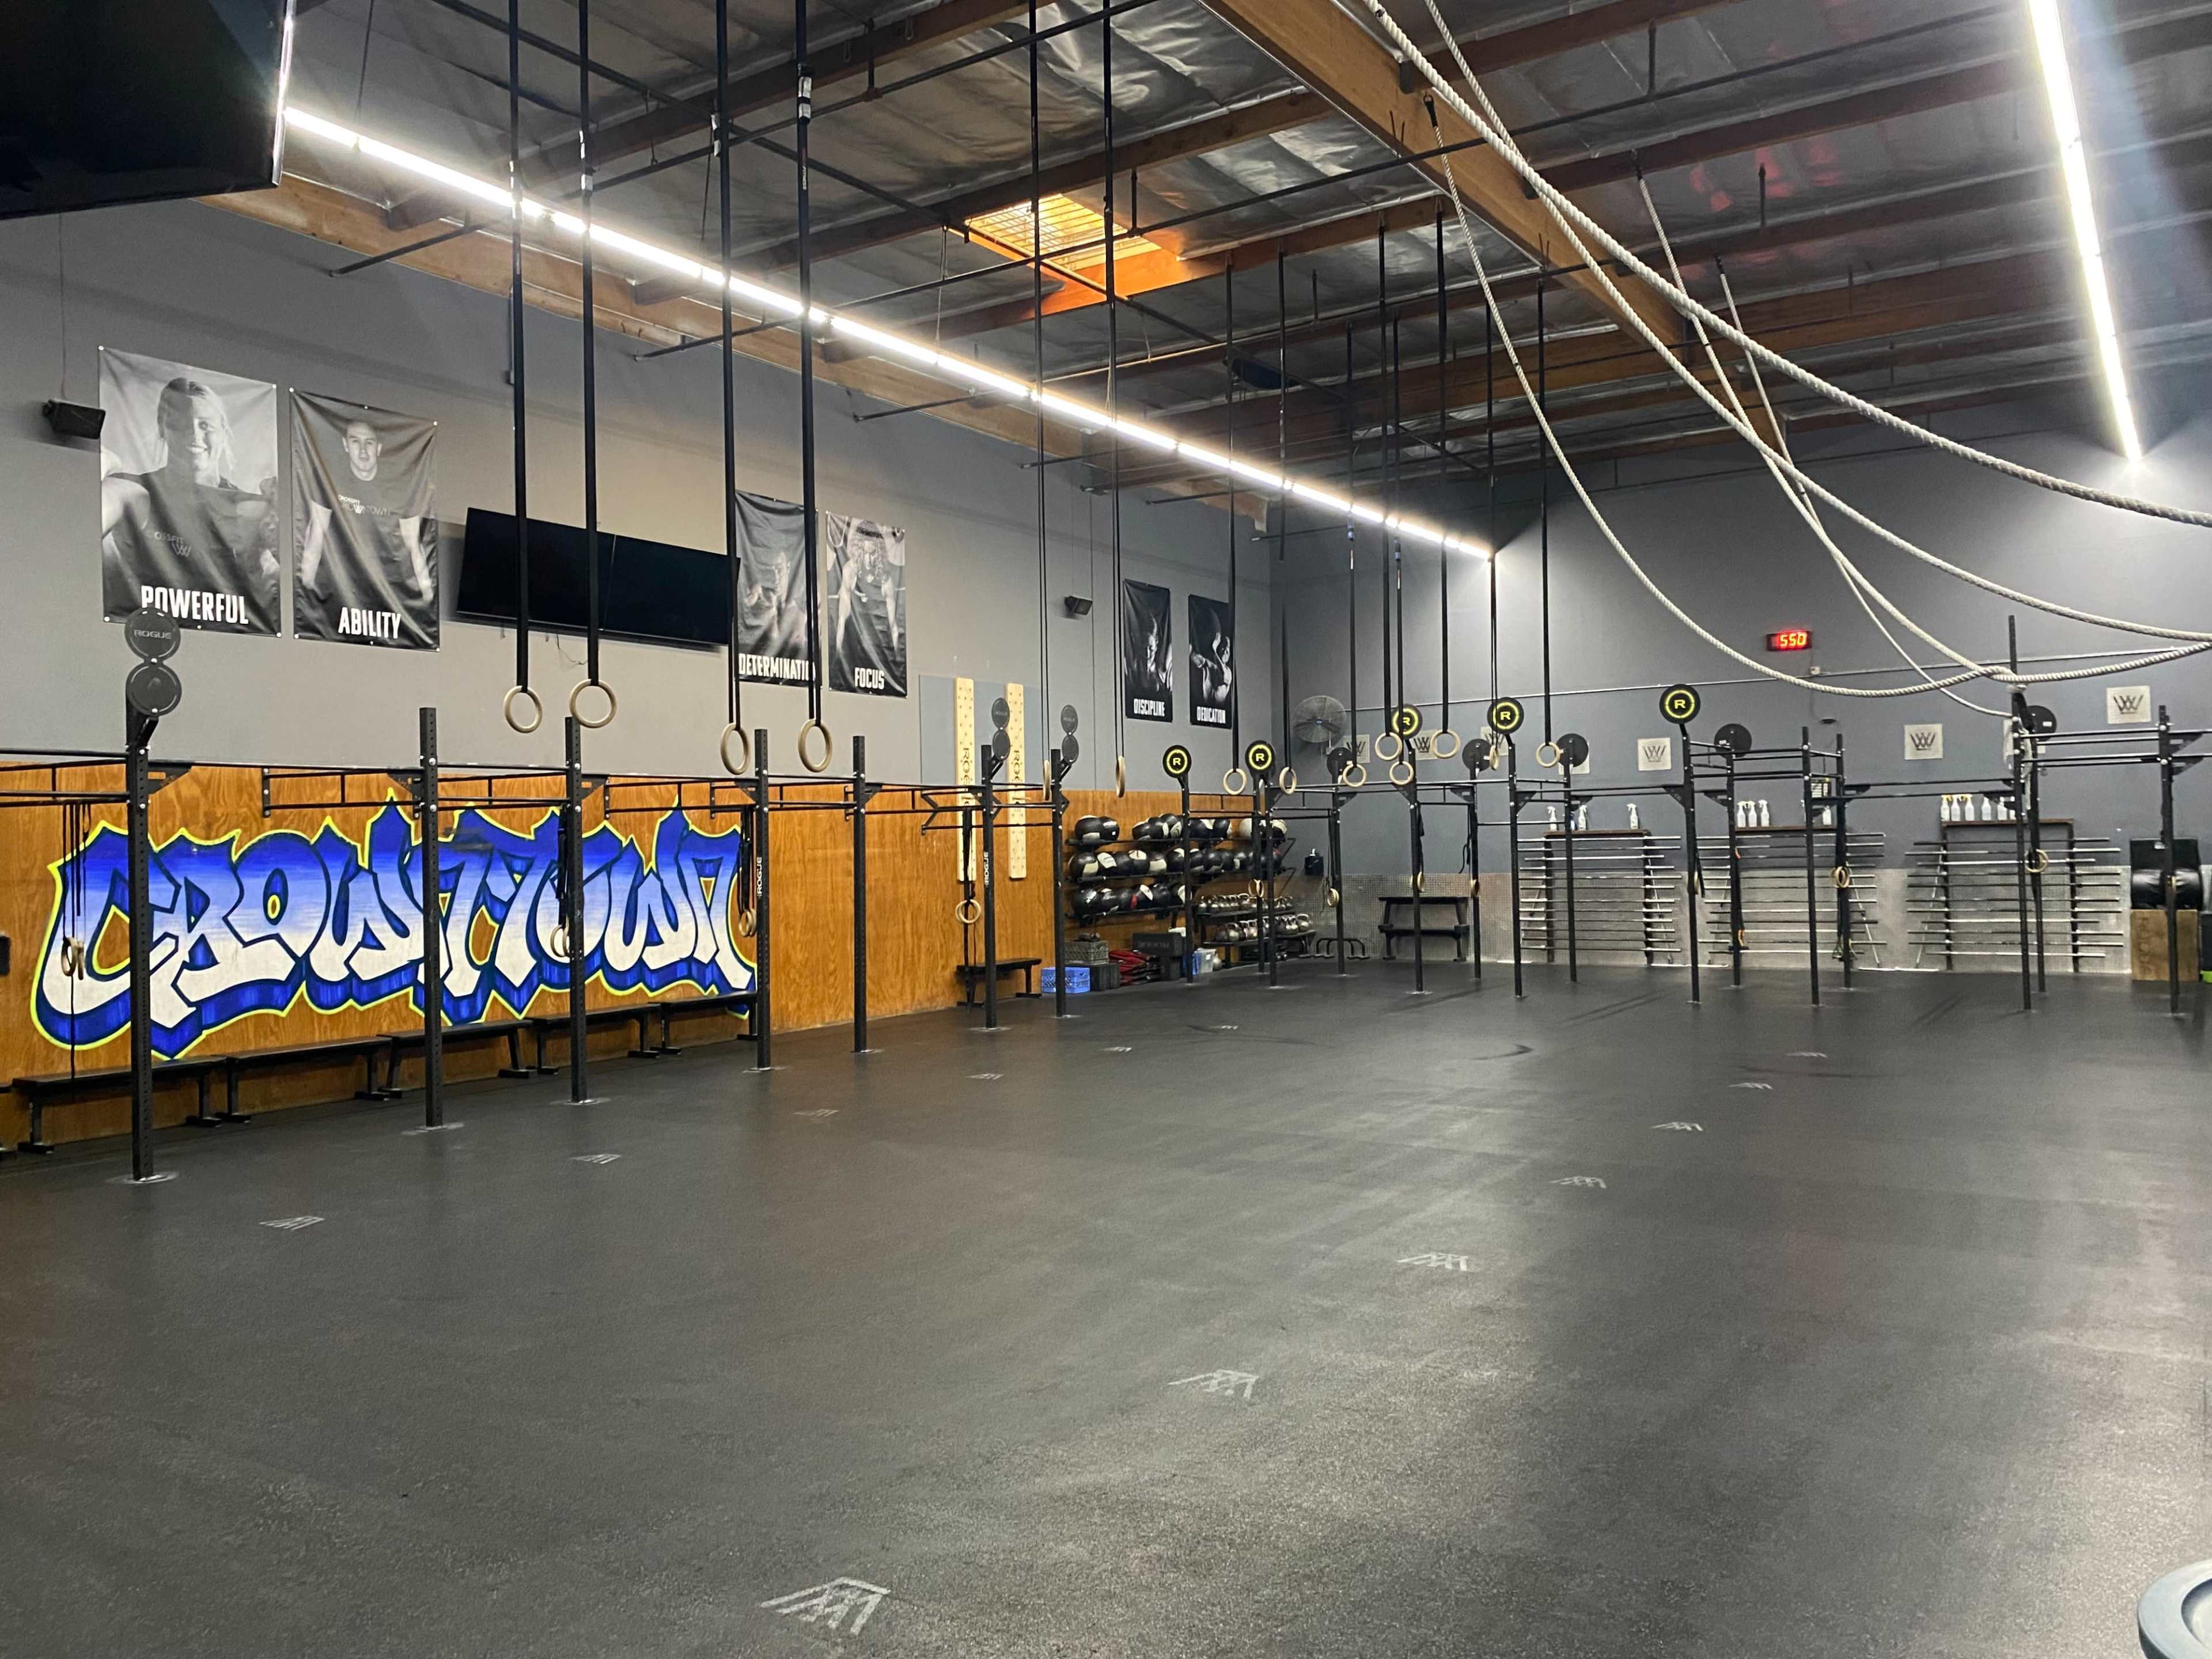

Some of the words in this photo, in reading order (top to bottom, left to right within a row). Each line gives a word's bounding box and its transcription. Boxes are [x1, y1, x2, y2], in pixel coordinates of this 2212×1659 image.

[141, 585, 248, 624] POWERFUL
[338, 607, 401, 639] ABILITY
[134, 630, 172, 639] ROGUE
[855, 667, 884, 690] FOCUS
[1134, 699, 1165, 717] DISCIPLINE
[1674, 699, 1686, 709] R
[1196, 706, 1226, 724] DEDICATION
[1500, 711, 1511, 720] R
[1173, 757, 1181, 766] R
[1256, 753, 1265, 762] R
